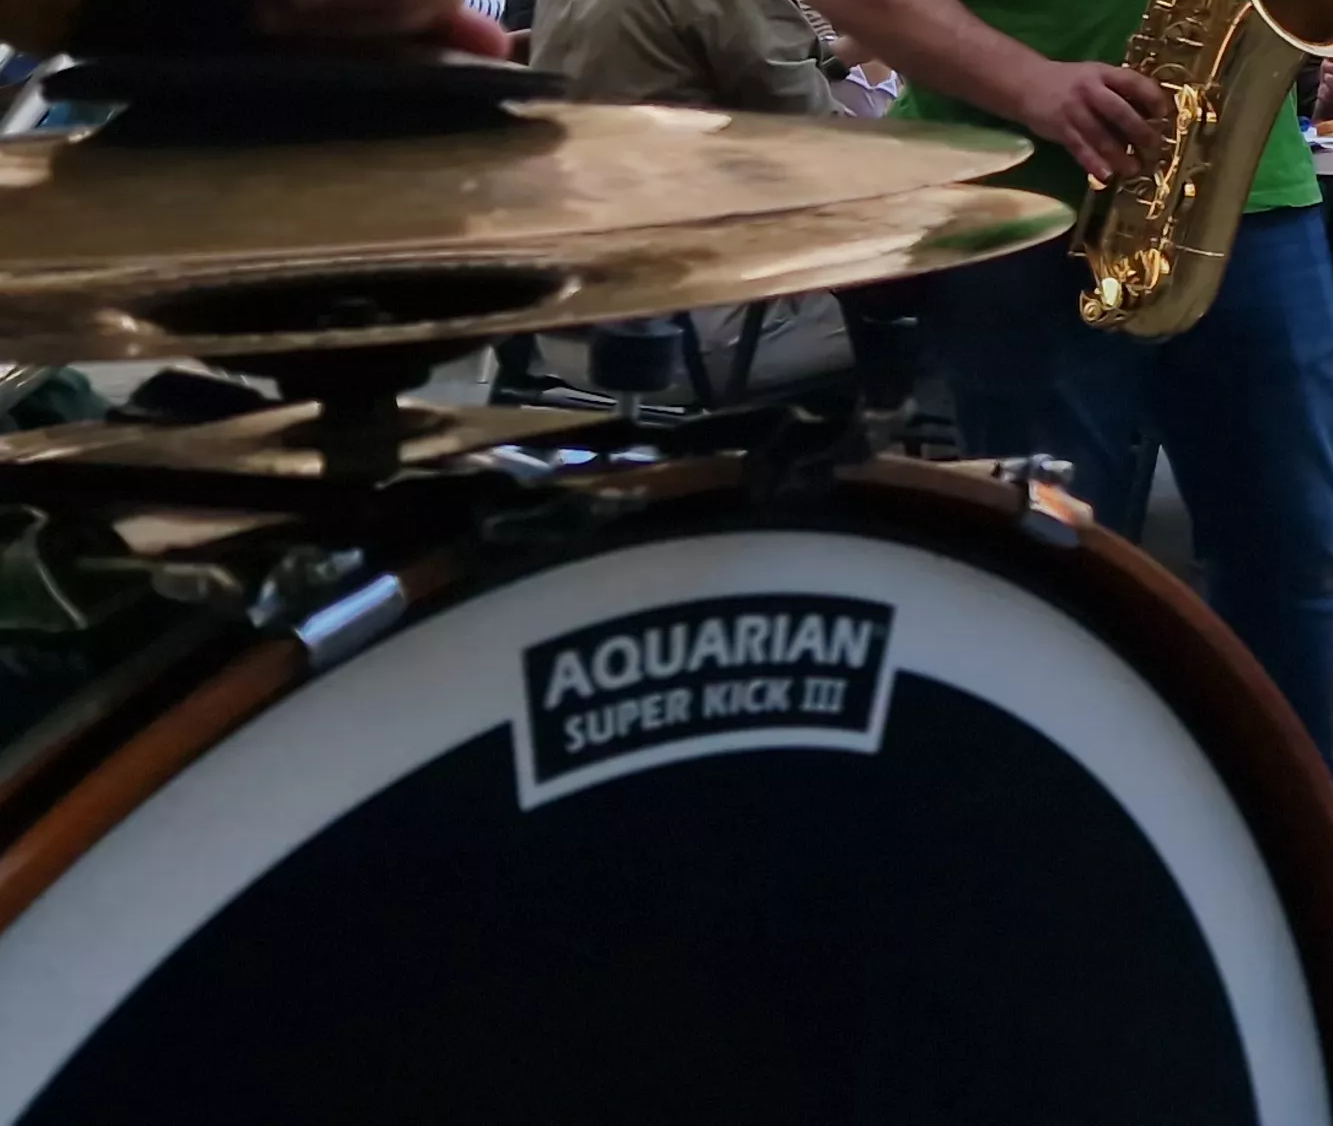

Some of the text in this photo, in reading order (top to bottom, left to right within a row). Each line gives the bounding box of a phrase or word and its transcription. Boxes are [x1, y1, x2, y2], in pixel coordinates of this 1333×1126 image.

[544, 613, 874, 710] AQUARIAN
[564, 677, 849, 753] SUPER KICK III
